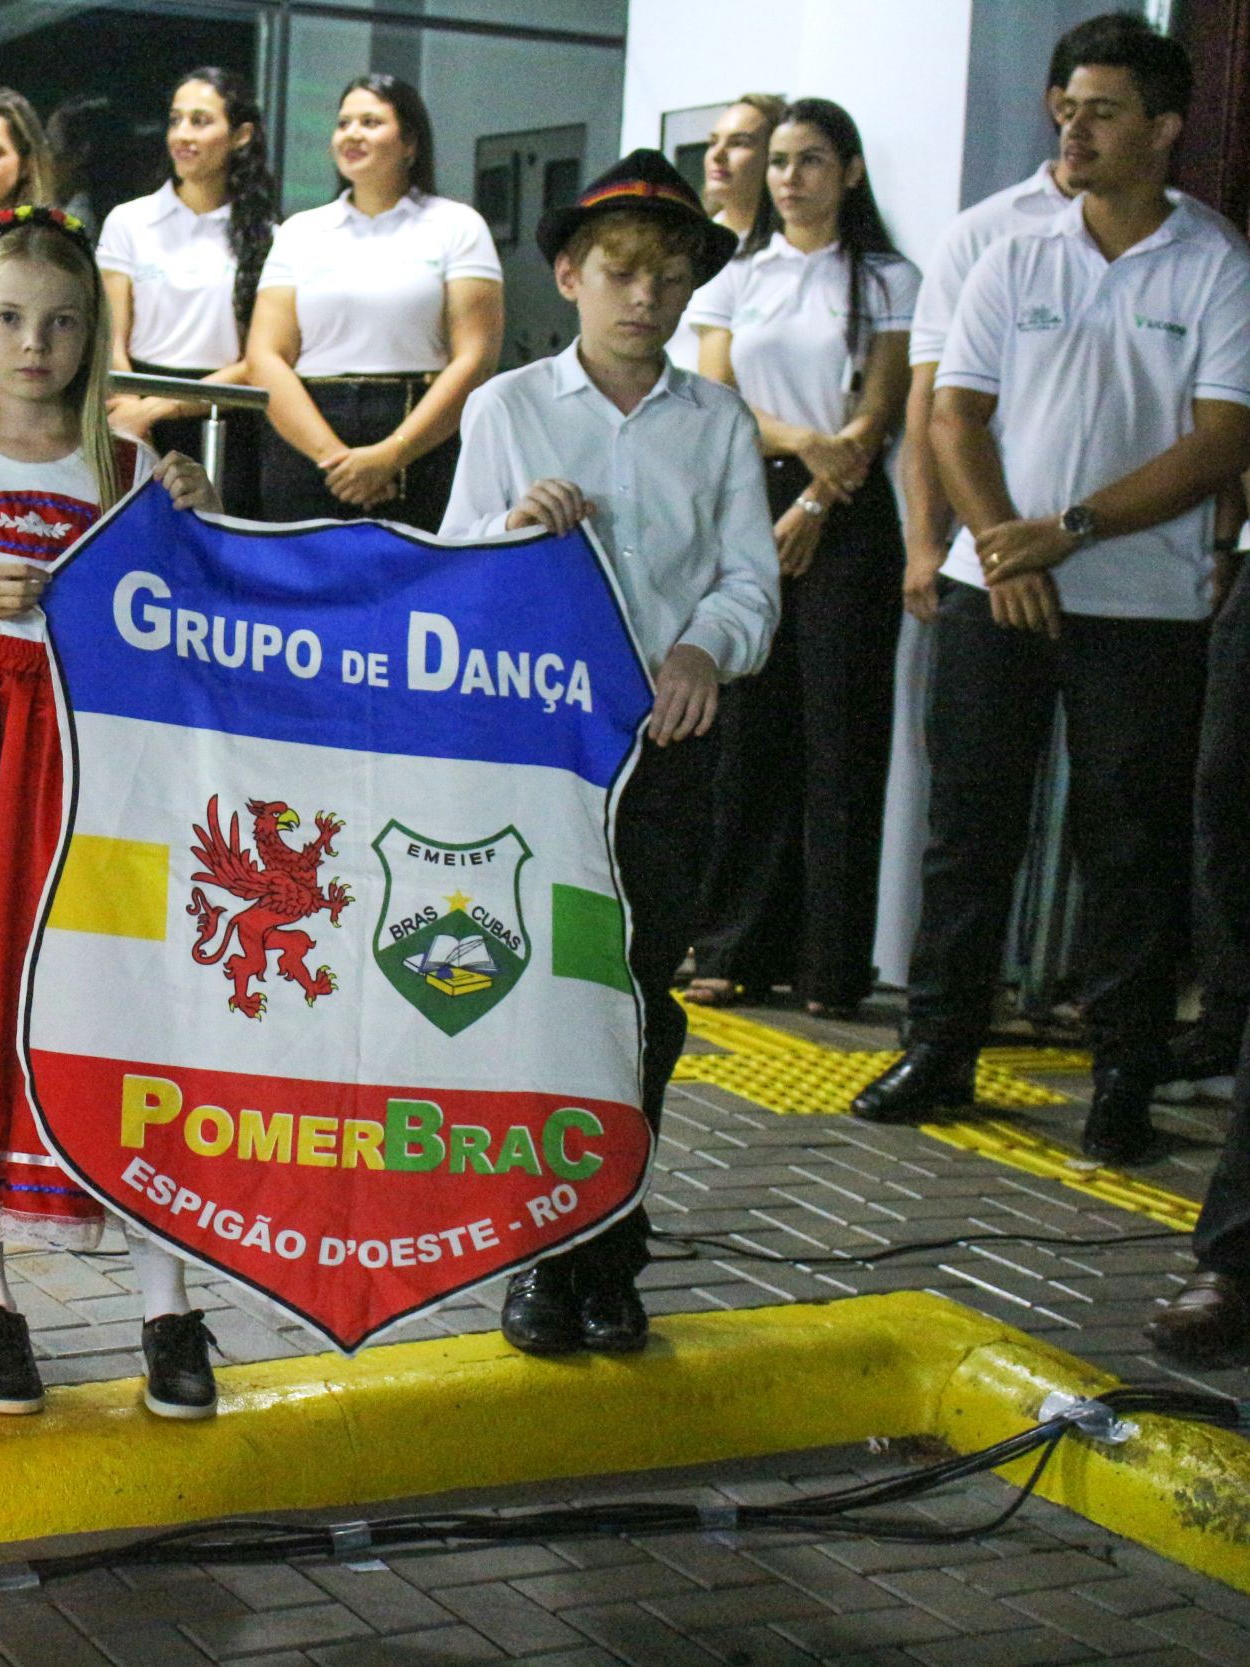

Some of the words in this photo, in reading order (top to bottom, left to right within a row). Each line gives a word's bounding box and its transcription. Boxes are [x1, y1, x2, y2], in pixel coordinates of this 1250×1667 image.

[112, 570, 323, 679] GRUPO
[341, 649, 390, 687] DE
[406, 843, 497, 867] EMEIEF
[389, 905, 439, 942] BRAS
[471, 905, 522, 951] CUBAS
[120, 1156, 307, 1261] ESPIGÃO
[526, 1183, 579, 1228] RO
